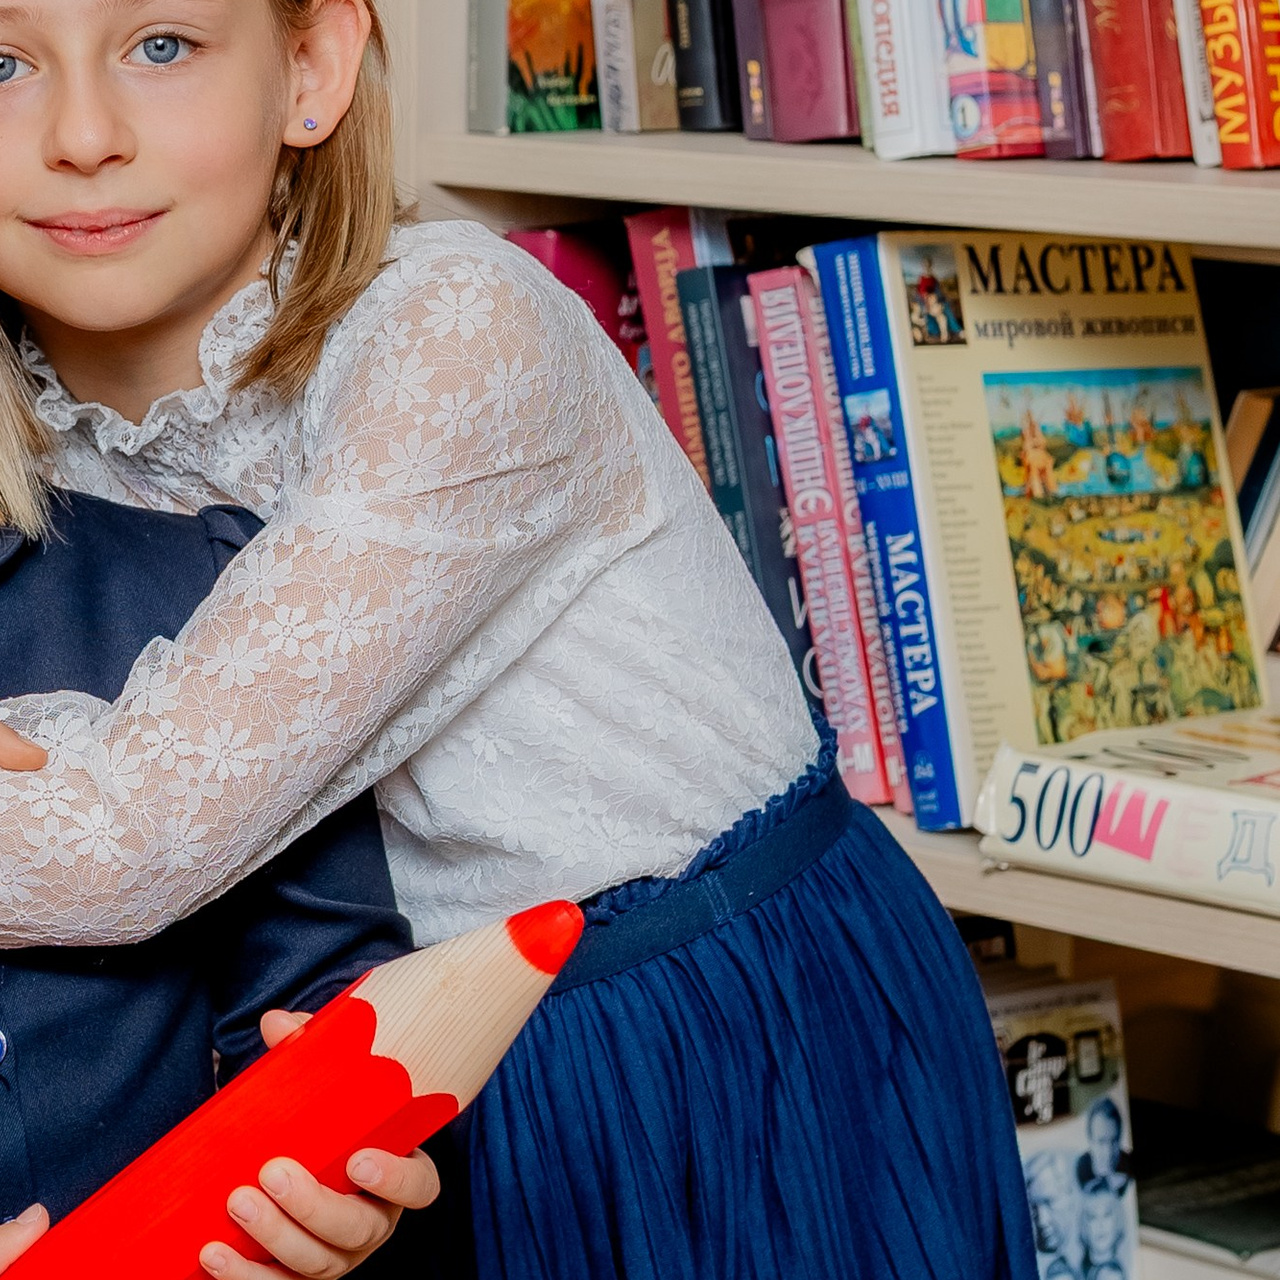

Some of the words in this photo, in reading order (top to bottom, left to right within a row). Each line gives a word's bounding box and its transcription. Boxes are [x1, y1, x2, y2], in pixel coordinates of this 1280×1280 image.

[966, 242, 1189, 296] МАСТЕРА
[973, 313, 1076, 349] мировой
[1080, 313, 1196, 342] живописи
[759, 285, 834, 517] ЭНЦИКЛОПЕДИЯ
[886, 532, 938, 717] МАСТЕРА
[1001, 761, 1105, 859] 500
